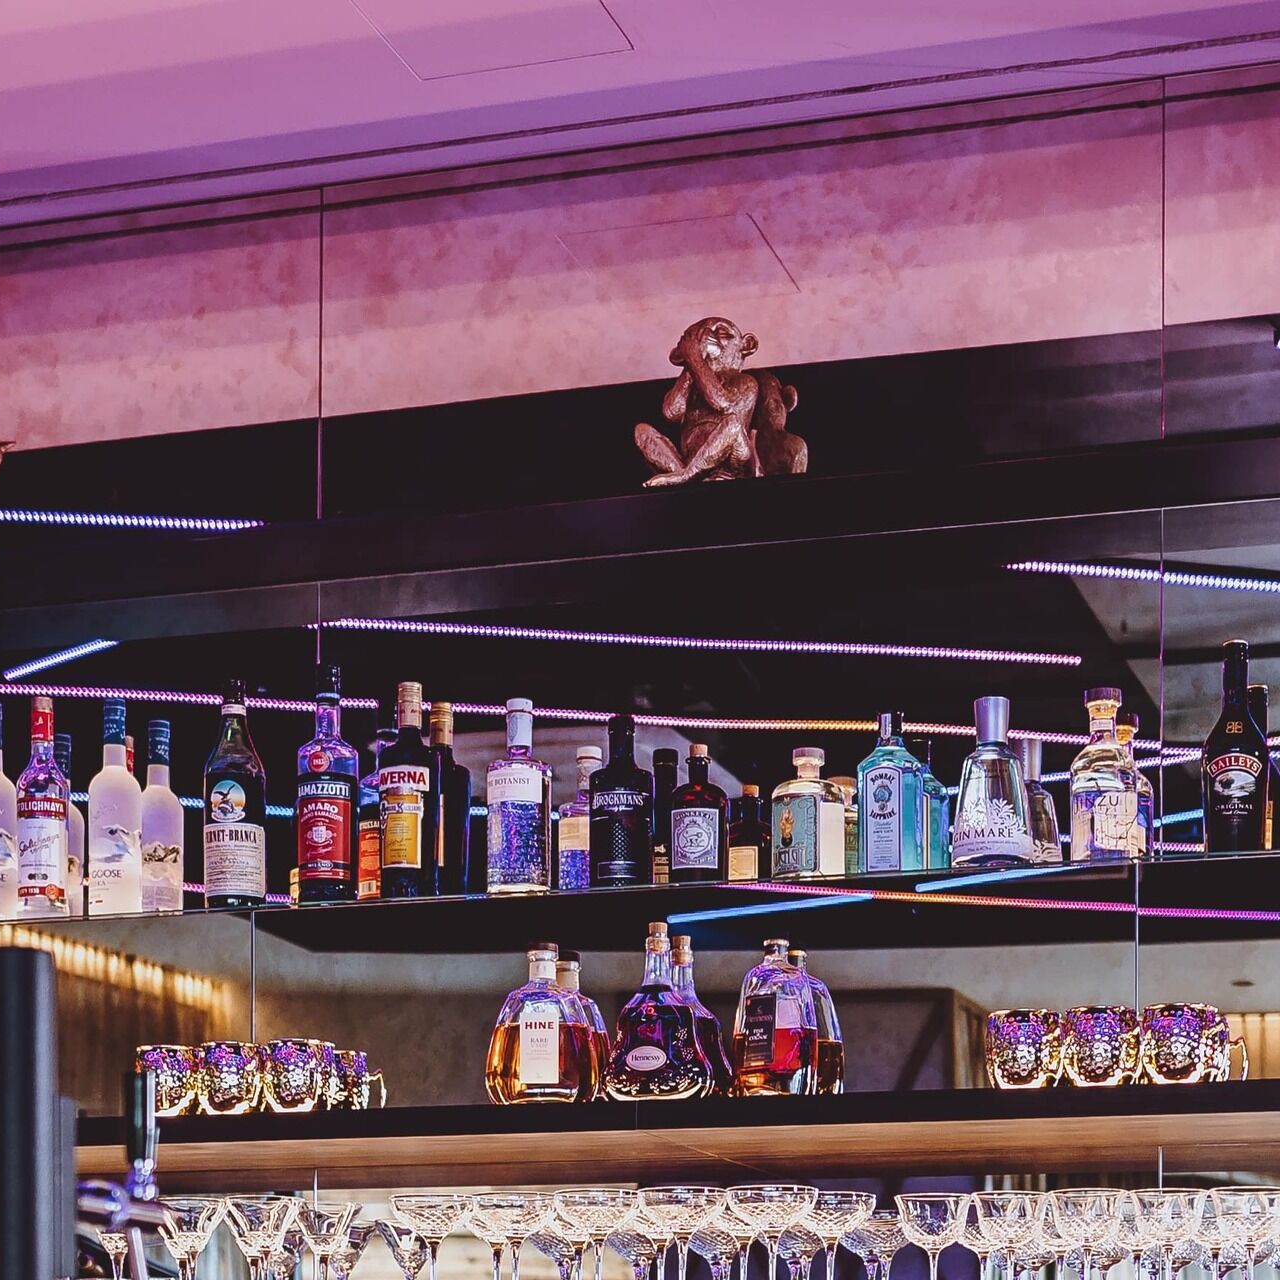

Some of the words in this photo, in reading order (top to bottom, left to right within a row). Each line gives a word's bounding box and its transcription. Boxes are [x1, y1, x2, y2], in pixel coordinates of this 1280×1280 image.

[1210, 757, 1260, 773] BAILEYS
[380, 771, 426, 785] AVERNA
[495, 777, 530, 786] BOTANIST
[870, 773, 896, 785] BOMBAY
[18, 801, 64, 812] TOLICHNAYA
[592, 793, 644, 809] BROCKMANS
[303, 802, 339, 814] AMARO
[869, 808, 897, 820] SAPPHIRE
[206, 829, 257, 844] ERNET-BRANCA
[954, 830, 970, 842] GIN
[974, 827, 1014, 838] MARE
[91, 869, 122, 878] GOOSE
[524, 1021, 554, 1030] HINE
[631, 1054, 661, 1063] Hennessy
